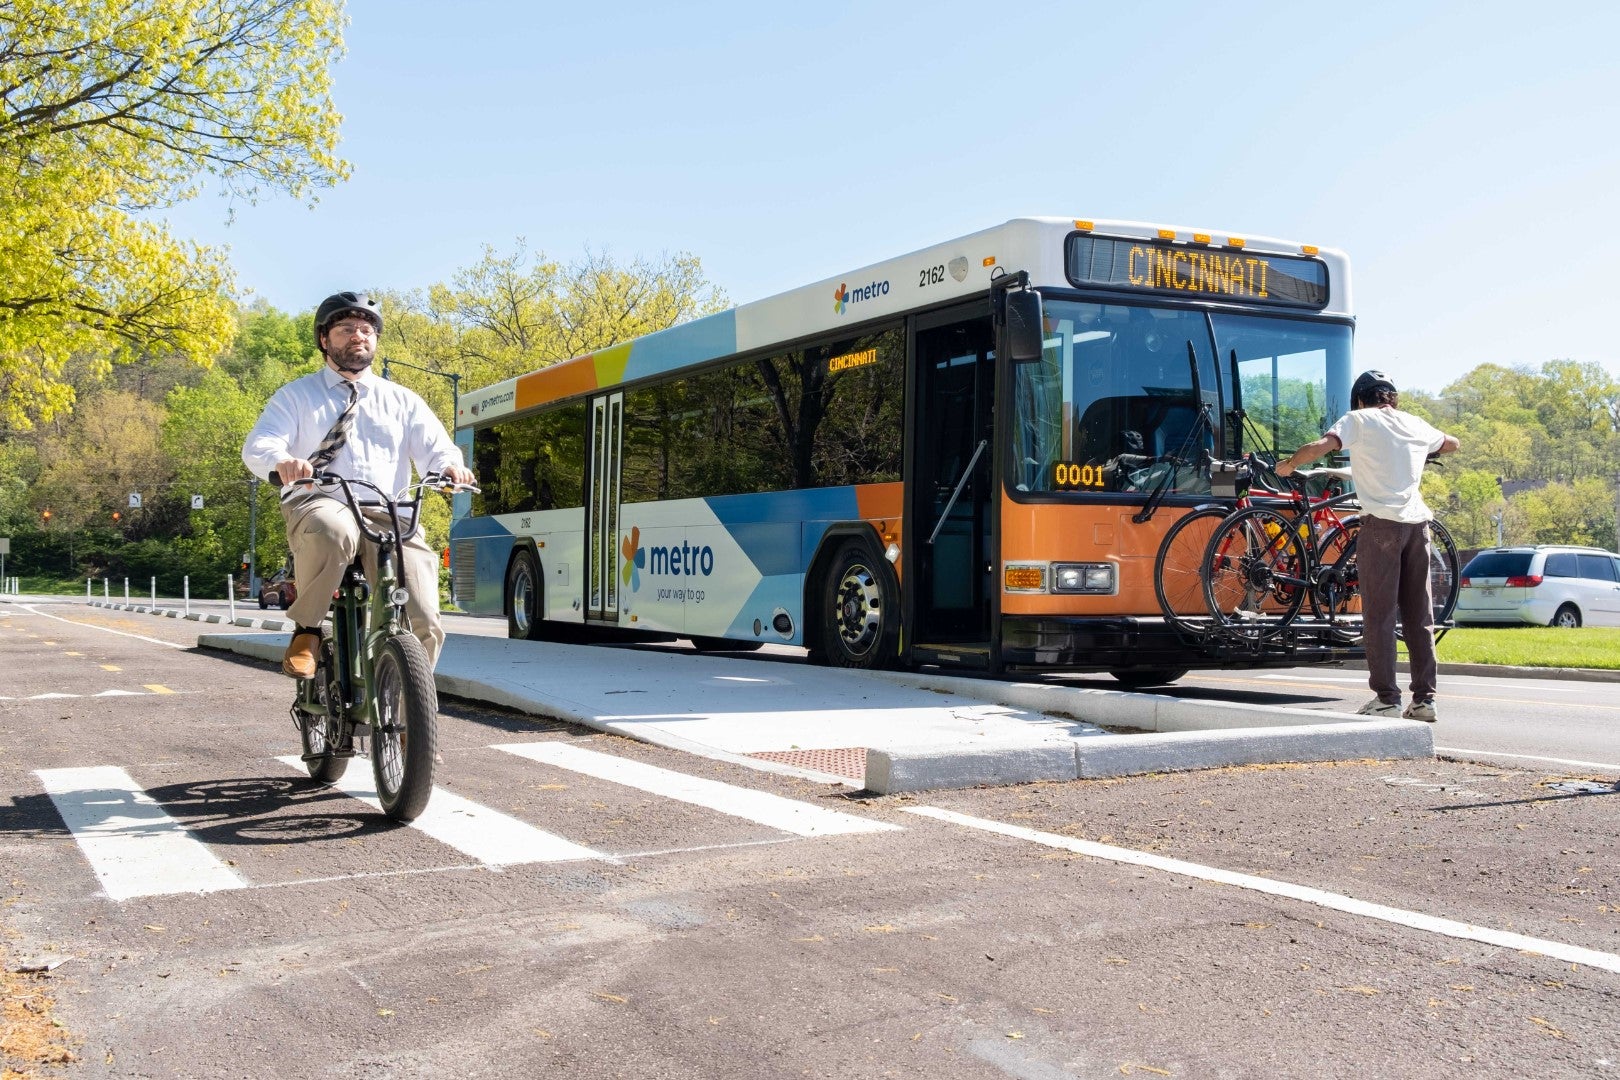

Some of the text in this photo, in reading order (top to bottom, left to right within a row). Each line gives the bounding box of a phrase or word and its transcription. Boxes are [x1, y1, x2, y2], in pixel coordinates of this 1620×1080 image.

[919, 265, 945, 287] 2162
[1129, 246, 1268, 297] CINCINNATI
[852, 280, 889, 303] metro
[829, 349, 876, 371] CINCINNATI
[481, 391, 514, 412] go-metro.com
[1056, 464, 1104, 486] 0001
[521, 517, 531, 528] 2162
[650, 540, 713, 576] metro
[657, 588, 705, 603] your way to go
